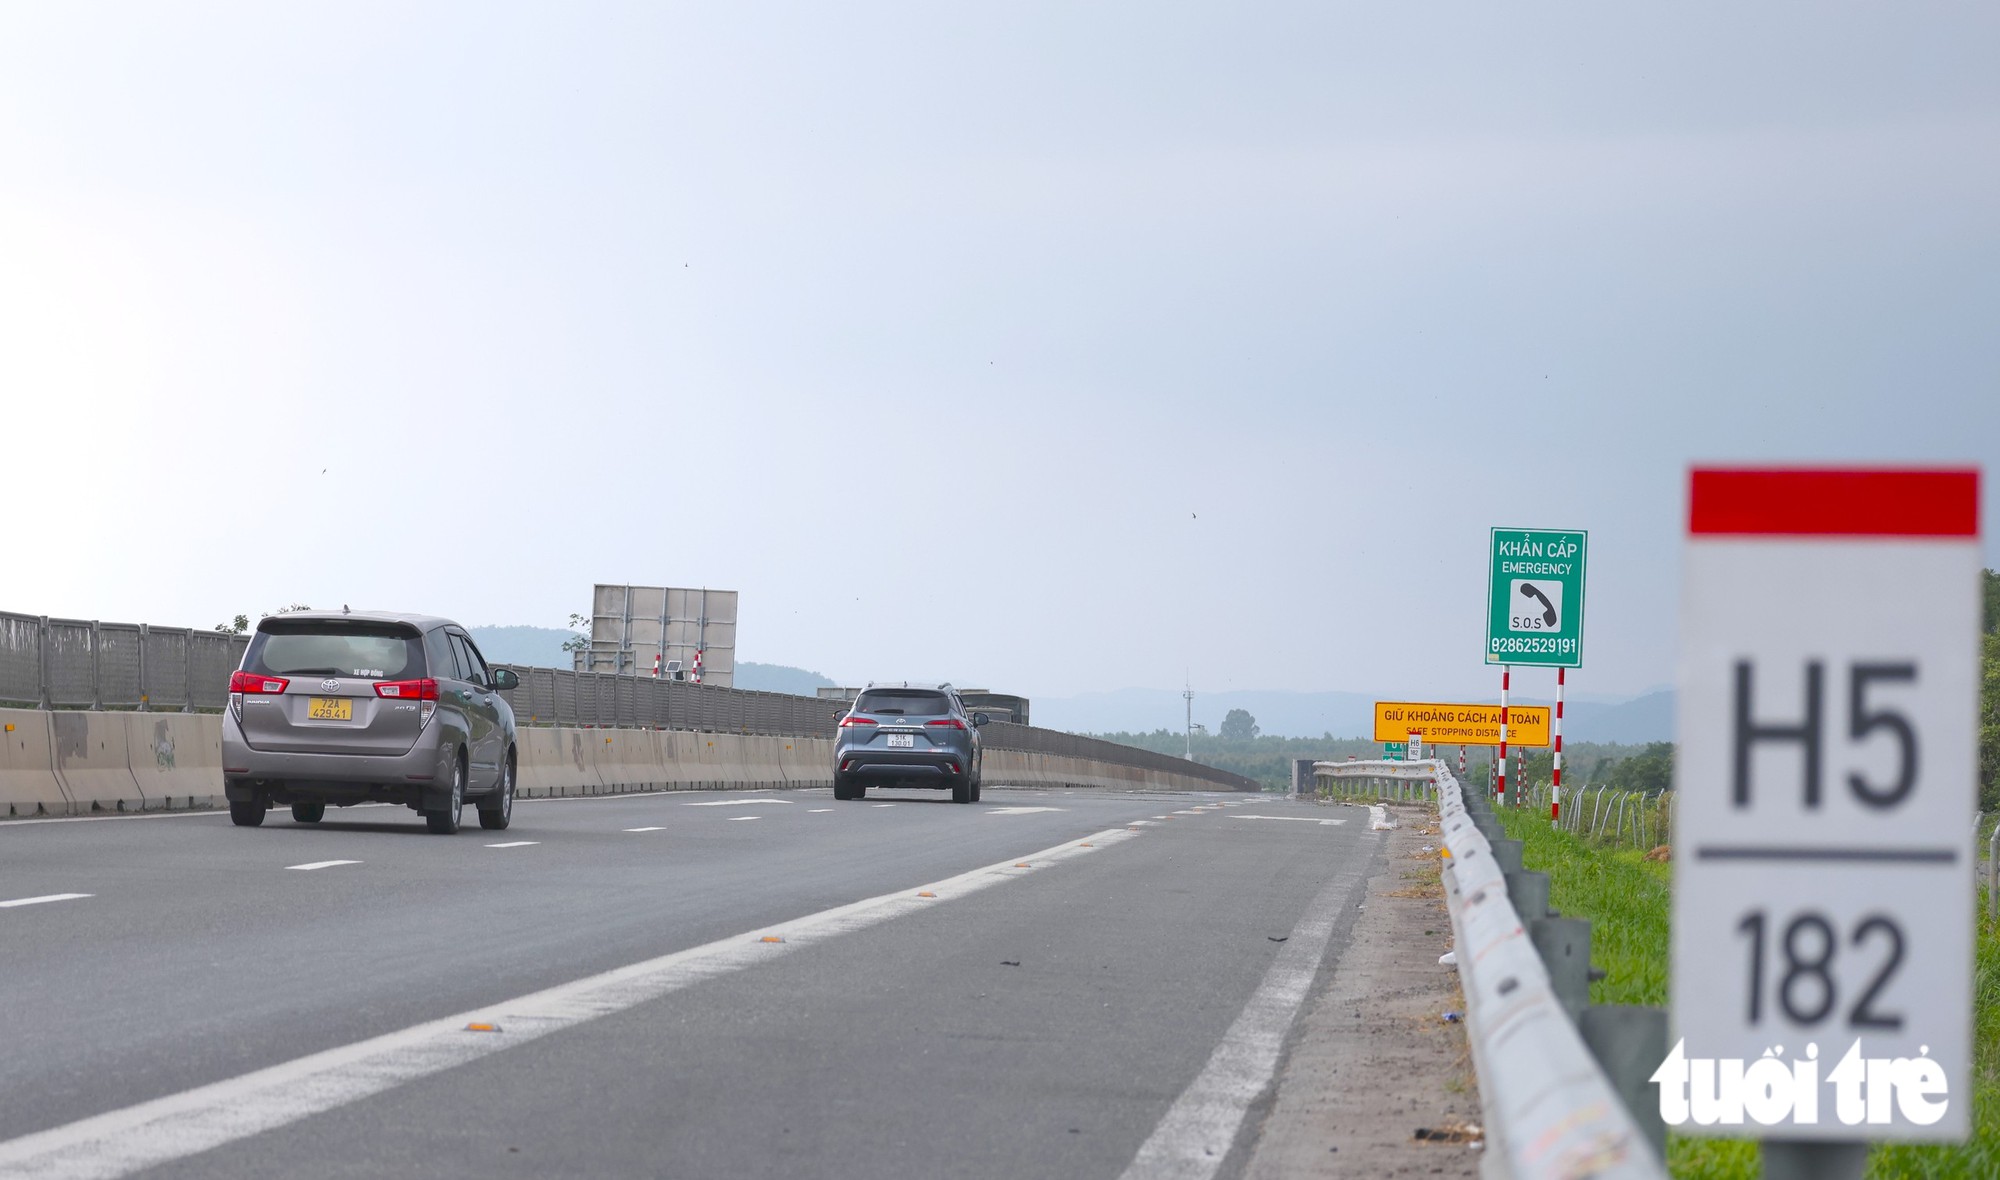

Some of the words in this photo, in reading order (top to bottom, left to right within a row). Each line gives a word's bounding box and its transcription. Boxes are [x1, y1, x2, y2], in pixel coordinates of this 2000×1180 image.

[1499, 533, 1543, 557] KHẨN
[1547, 536, 1577, 558] CẤP
[1502, 561, 1572, 575] EMERGENCY
[321, 698, 340, 708] 72A
[312, 708, 347, 719] 429.41
[1384, 708, 1404, 721] GIỮ
[1407, 708, 1454, 723] KHOẢNG
[1458, 710, 1487, 723] CÁCH
[1510, 712, 1540, 725] TOÀN
[1431, 727, 1473, 737] STOPPING
[1476, 728, 1517, 738] DISTACE
[1729, 656, 1922, 813] H5
[1410, 739, 1420, 747] H6
[1735, 904, 1910, 1033] 182
